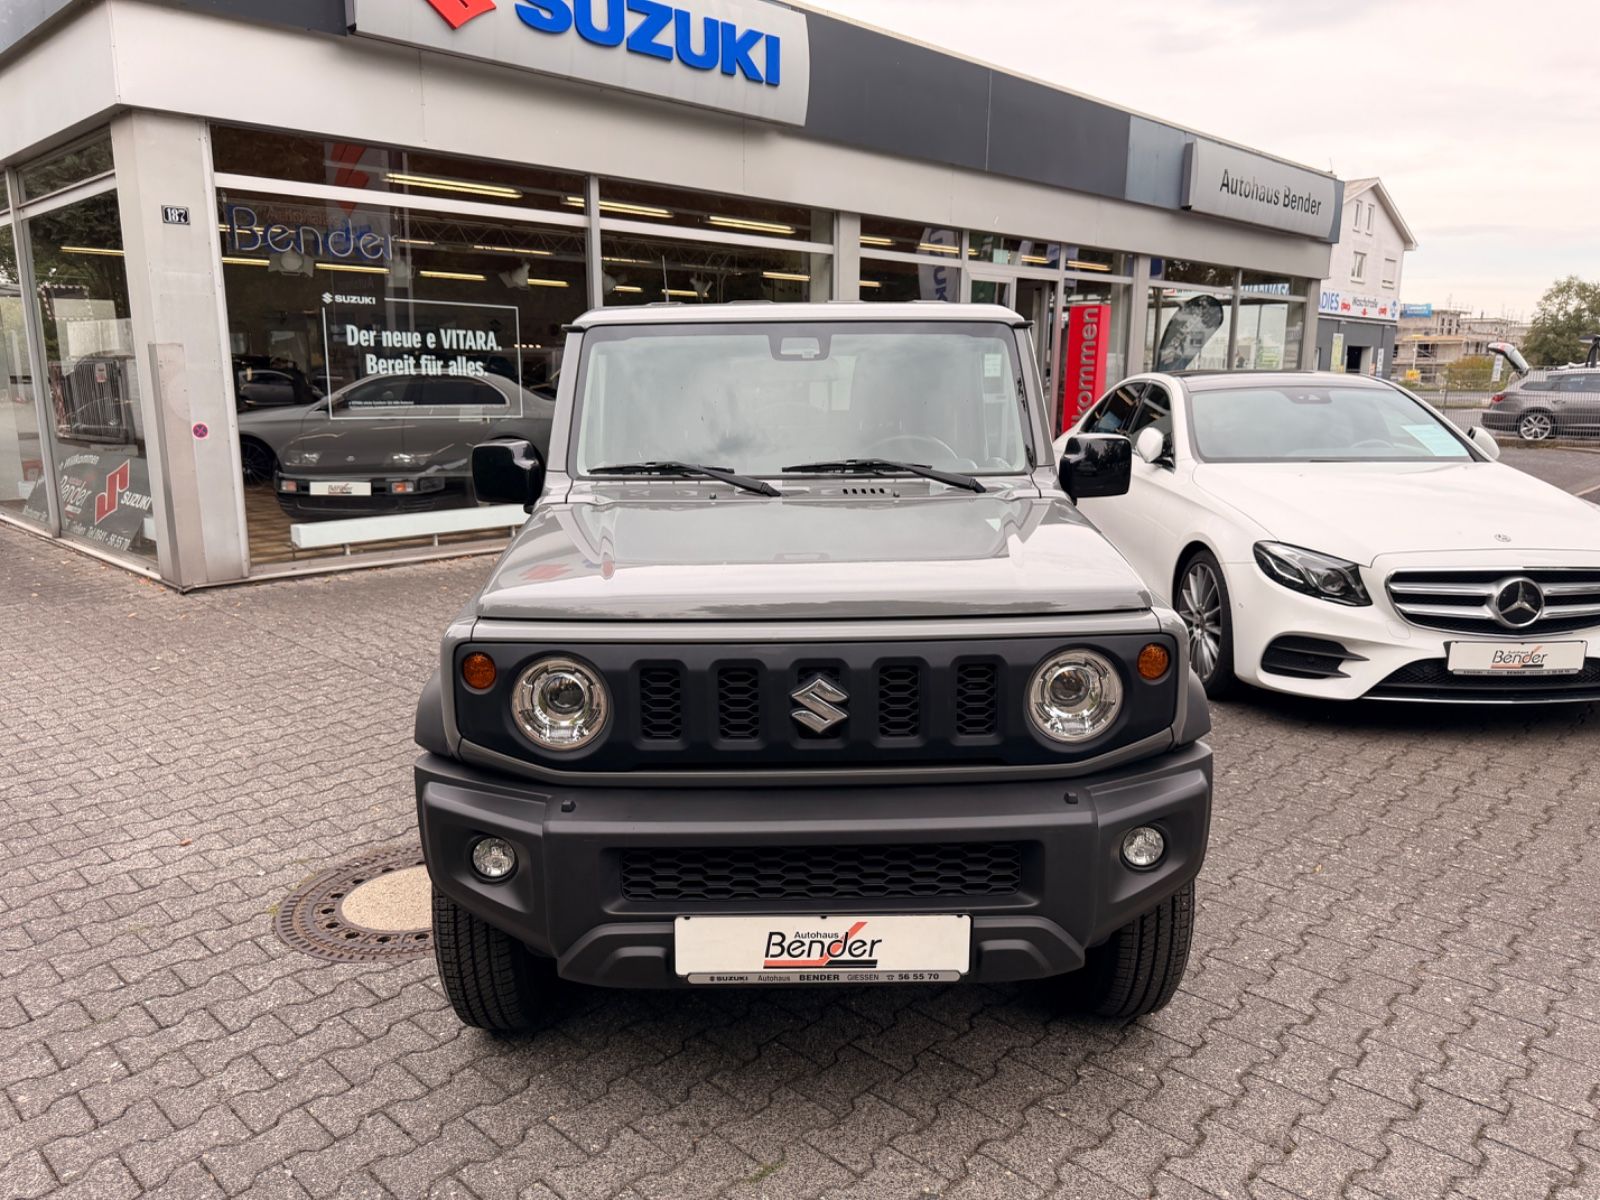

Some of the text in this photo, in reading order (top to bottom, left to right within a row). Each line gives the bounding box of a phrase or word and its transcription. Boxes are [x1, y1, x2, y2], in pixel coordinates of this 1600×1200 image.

[515, 0, 780, 86] SUZUKI
[1220, 169, 1321, 215] Autohaus Bender
[166, 207, 186, 222] 187
[232, 206, 399, 261] Bender
[334, 294, 376, 304] SUZUKI
[346, 324, 502, 351] Der neue e VITARA.
[365, 354, 489, 376] Bereit für alles.
[1491, 650, 1548, 664] Bender
[764, 931, 882, 958] Bender
[794, 931, 839, 940] Autohaus
[757, 974, 791, 982] Autohaus
[799, 973, 840, 982] BENDER
[846, 973, 879, 981] GIESSEN
[898, 973, 910, 981] 56
[912, 973, 925, 981] 55
[927, 973, 940, 981] 70
